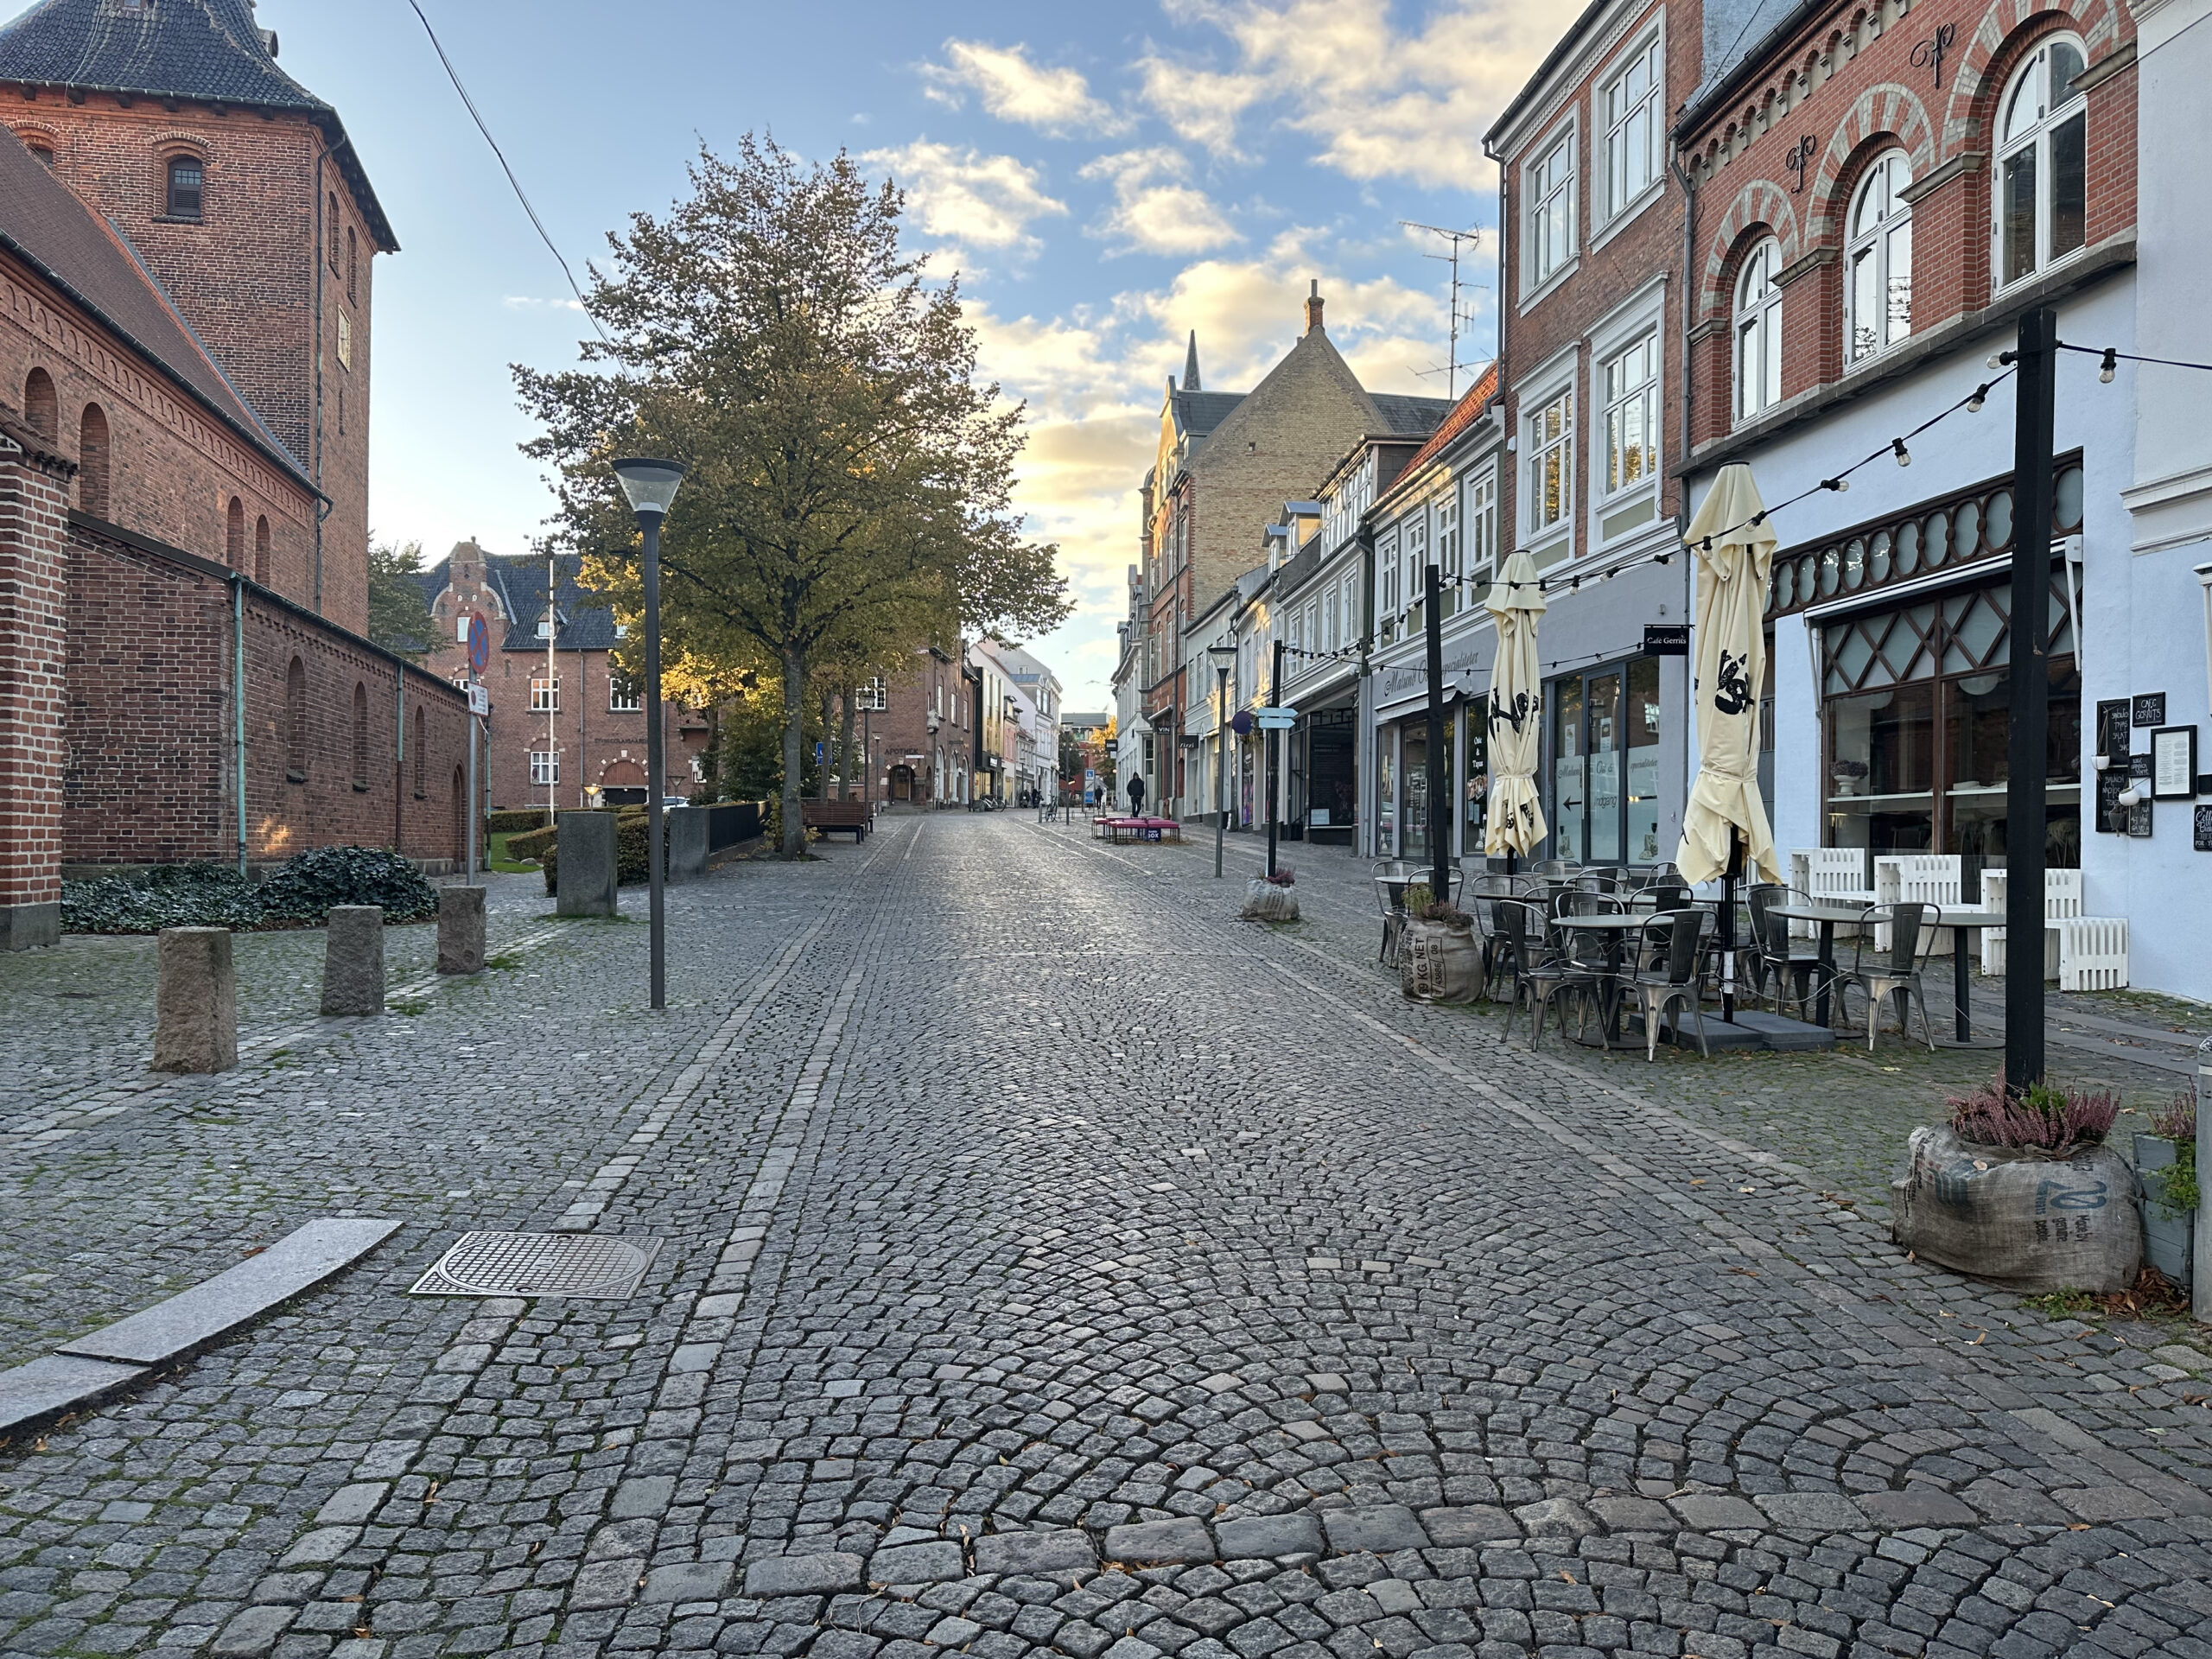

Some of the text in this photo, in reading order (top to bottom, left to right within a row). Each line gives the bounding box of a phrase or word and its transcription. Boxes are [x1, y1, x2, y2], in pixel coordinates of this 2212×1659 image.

[1415, 938, 1429, 995] 69 KG NET
